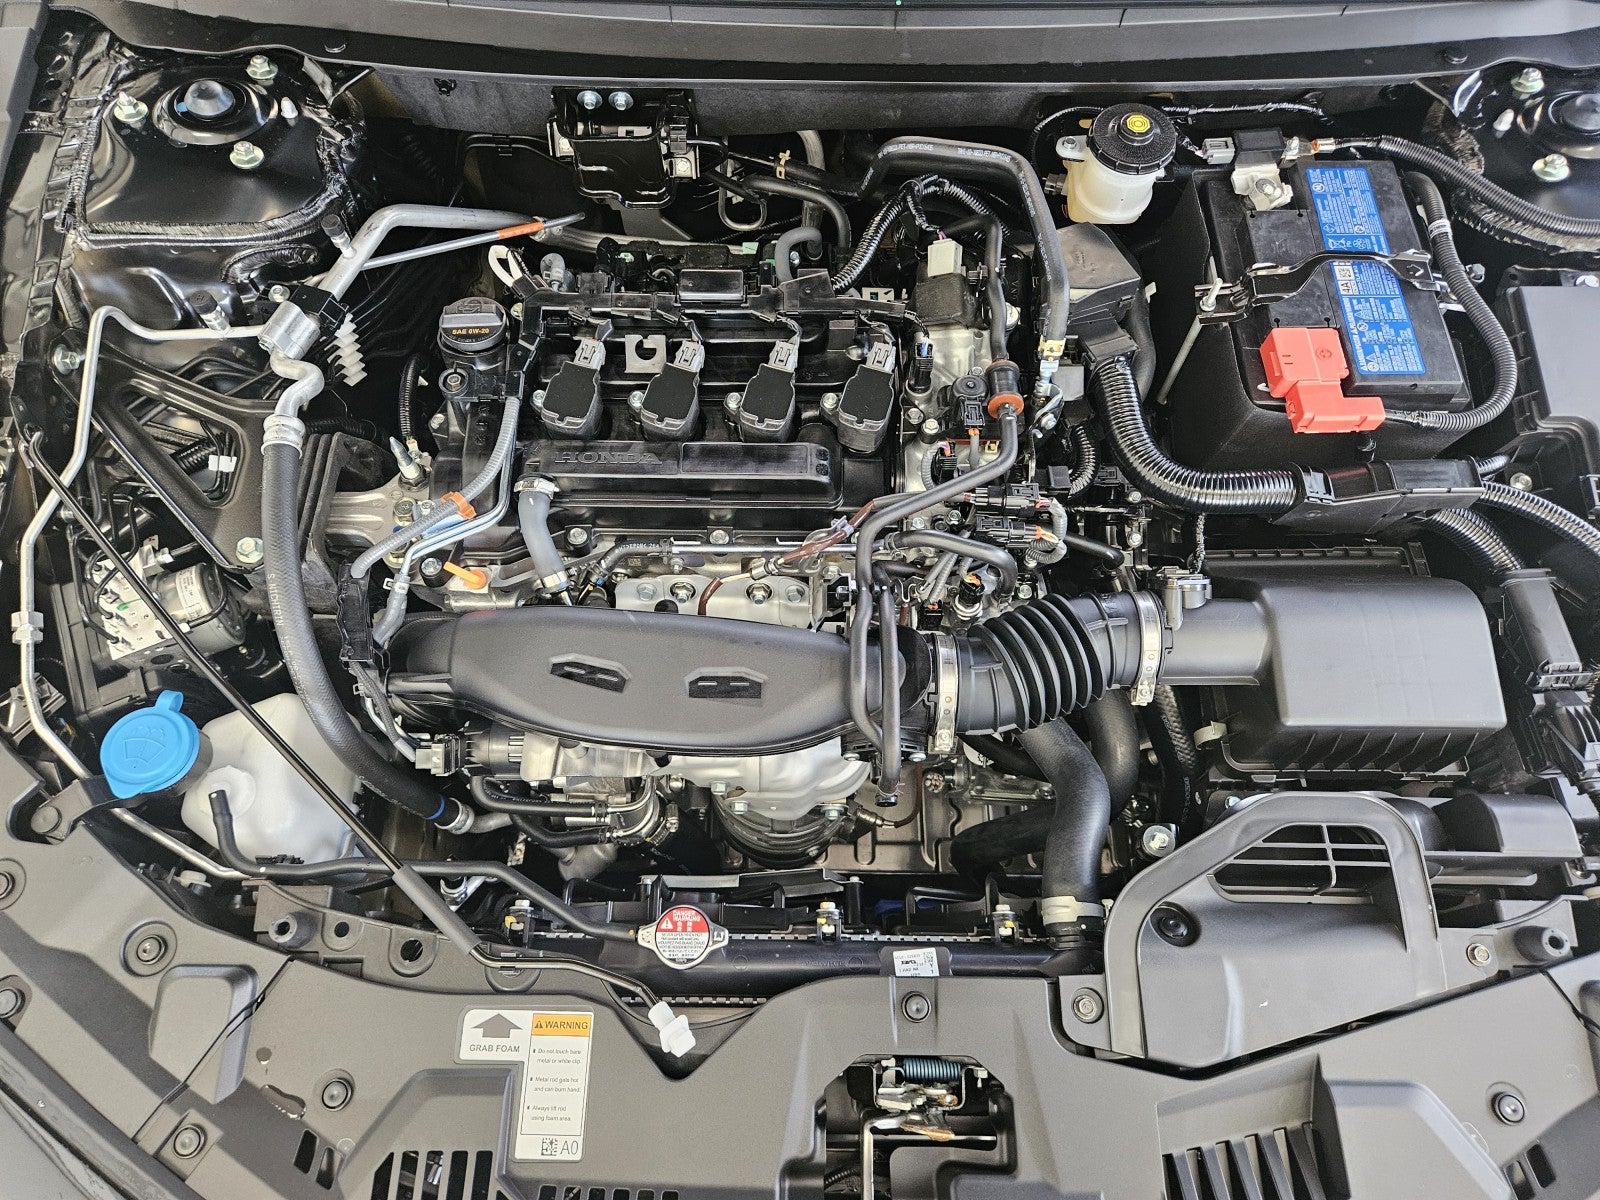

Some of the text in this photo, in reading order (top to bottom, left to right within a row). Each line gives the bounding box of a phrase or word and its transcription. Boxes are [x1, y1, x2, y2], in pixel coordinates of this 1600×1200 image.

[554, 451, 663, 465] HONDA
[545, 1021, 588, 1030] WARNING
[469, 1044, 520, 1053] GRAB FOAM
[560, 1140, 579, 1156] A0
